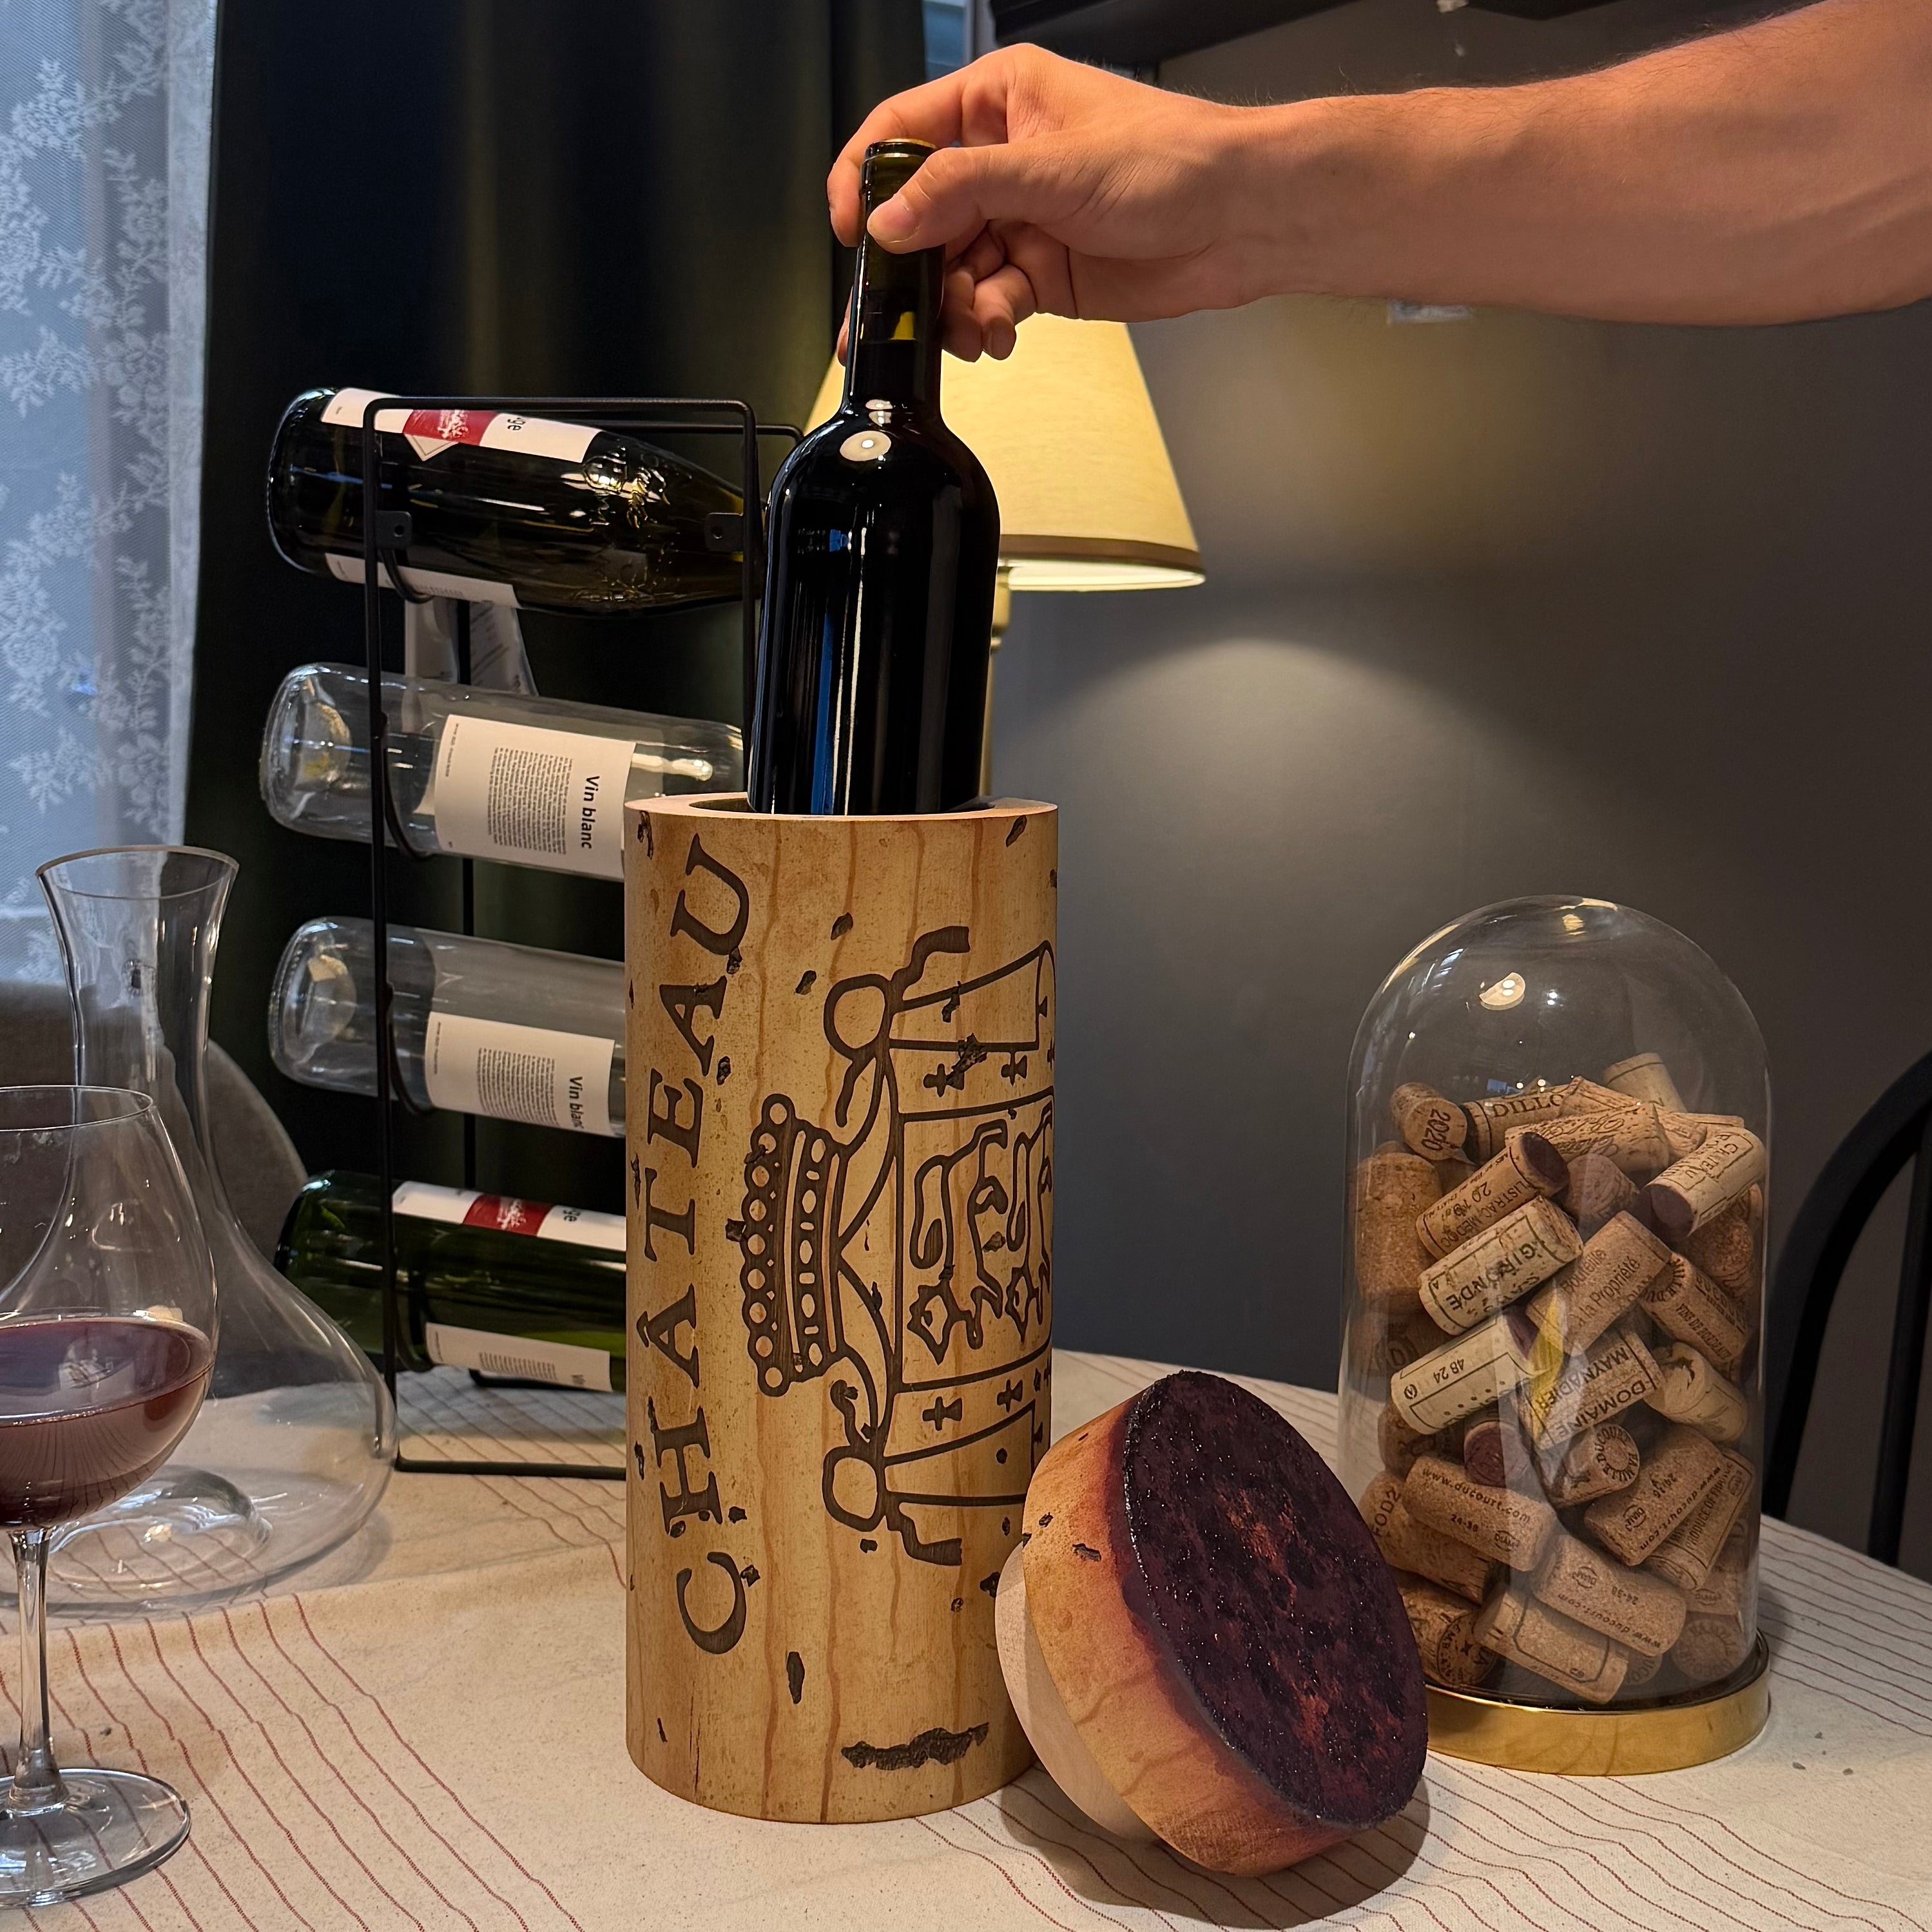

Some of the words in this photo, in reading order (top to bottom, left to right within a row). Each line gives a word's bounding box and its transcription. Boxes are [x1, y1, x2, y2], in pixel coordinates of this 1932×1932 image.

[583, 775, 600, 802] Vin
[581, 807, 597, 849] blanc
[568, 1076, 583, 1099] Vin
[1421, 1108, 1451, 1152] 2020
[1445, 1243, 1536, 1311] GIRONDE
[1579, 1304, 1597, 1319] la
[1589, 1255, 1641, 1307] Propriété
[1433, 1366, 1449, 1384] 24
[1536, 1347, 1629, 1411] MAYNADIER
[1556, 1379, 1646, 1436] DOMAINE
[1422, 1469, 1531, 1523] www.ducourt.com
[1640, 1466, 1721, 1550] www.ducourt.com
[1450, 1514, 1479, 1532] 24-38
